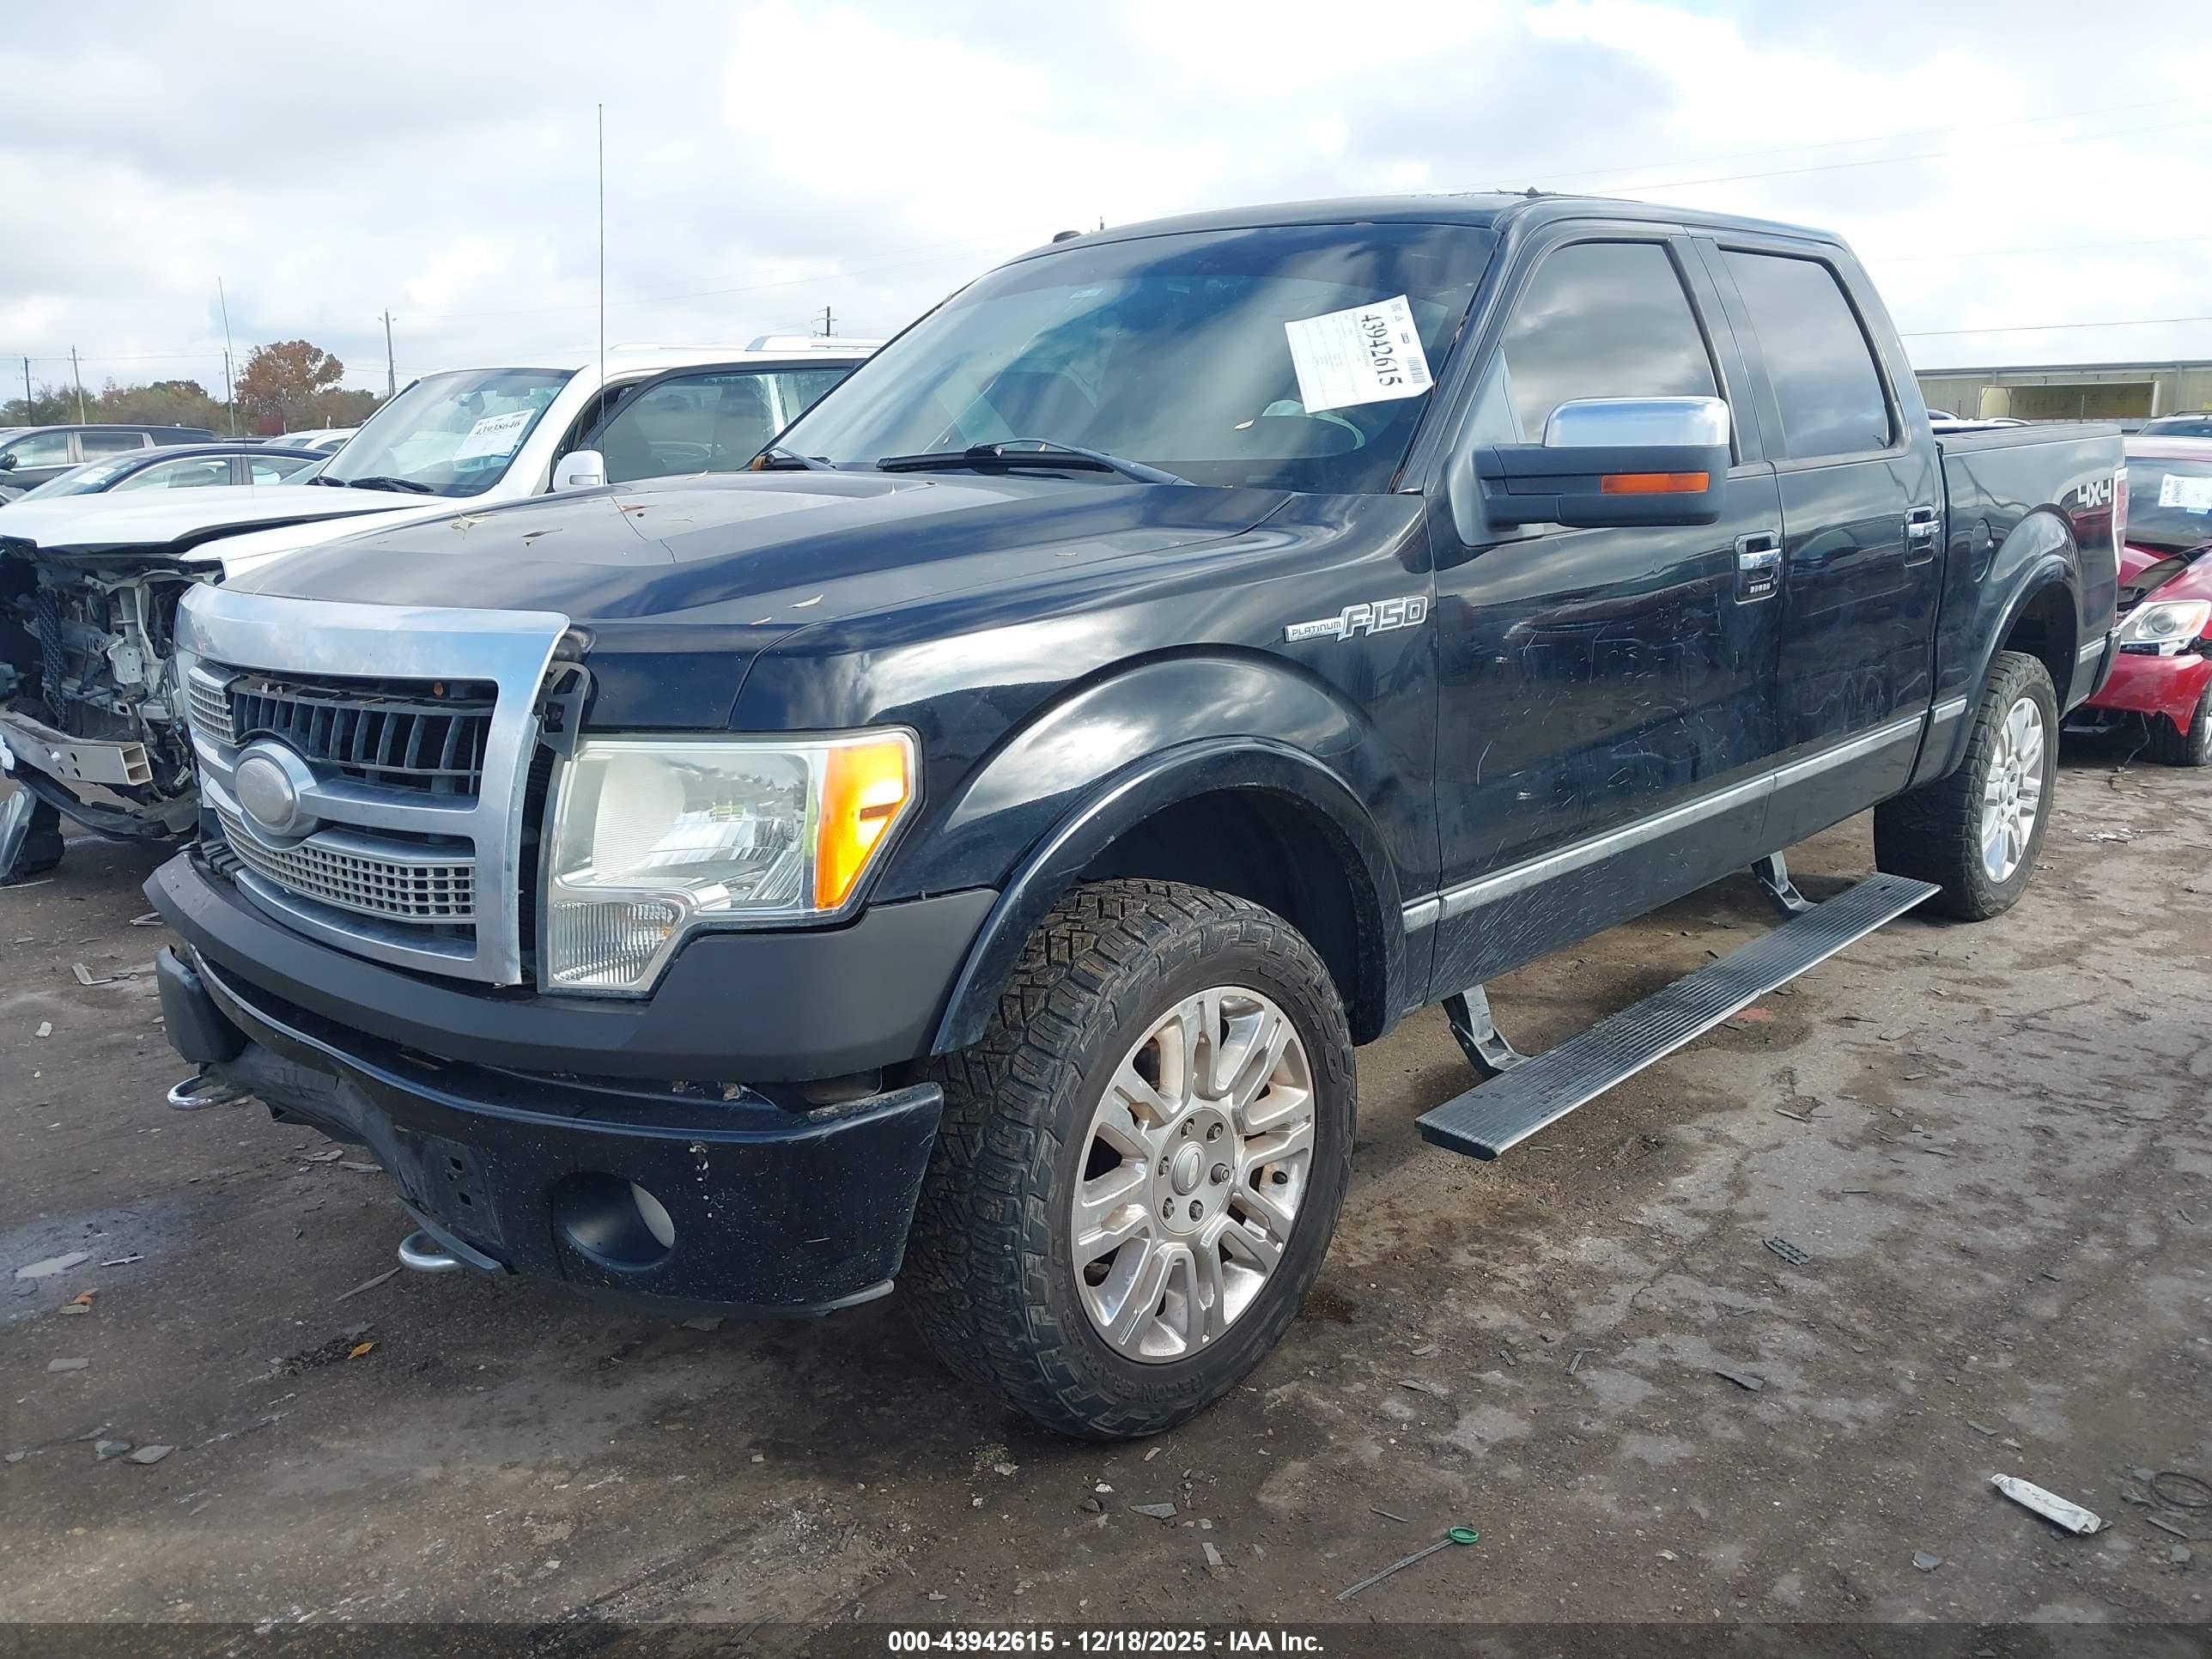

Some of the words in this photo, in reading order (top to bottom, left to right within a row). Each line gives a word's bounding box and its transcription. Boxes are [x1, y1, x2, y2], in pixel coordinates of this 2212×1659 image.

[1361, 313, 1403, 386] 43942615
[1291, 621, 1341, 637] PLATINUM
[1336, 596, 1428, 642] F-150
